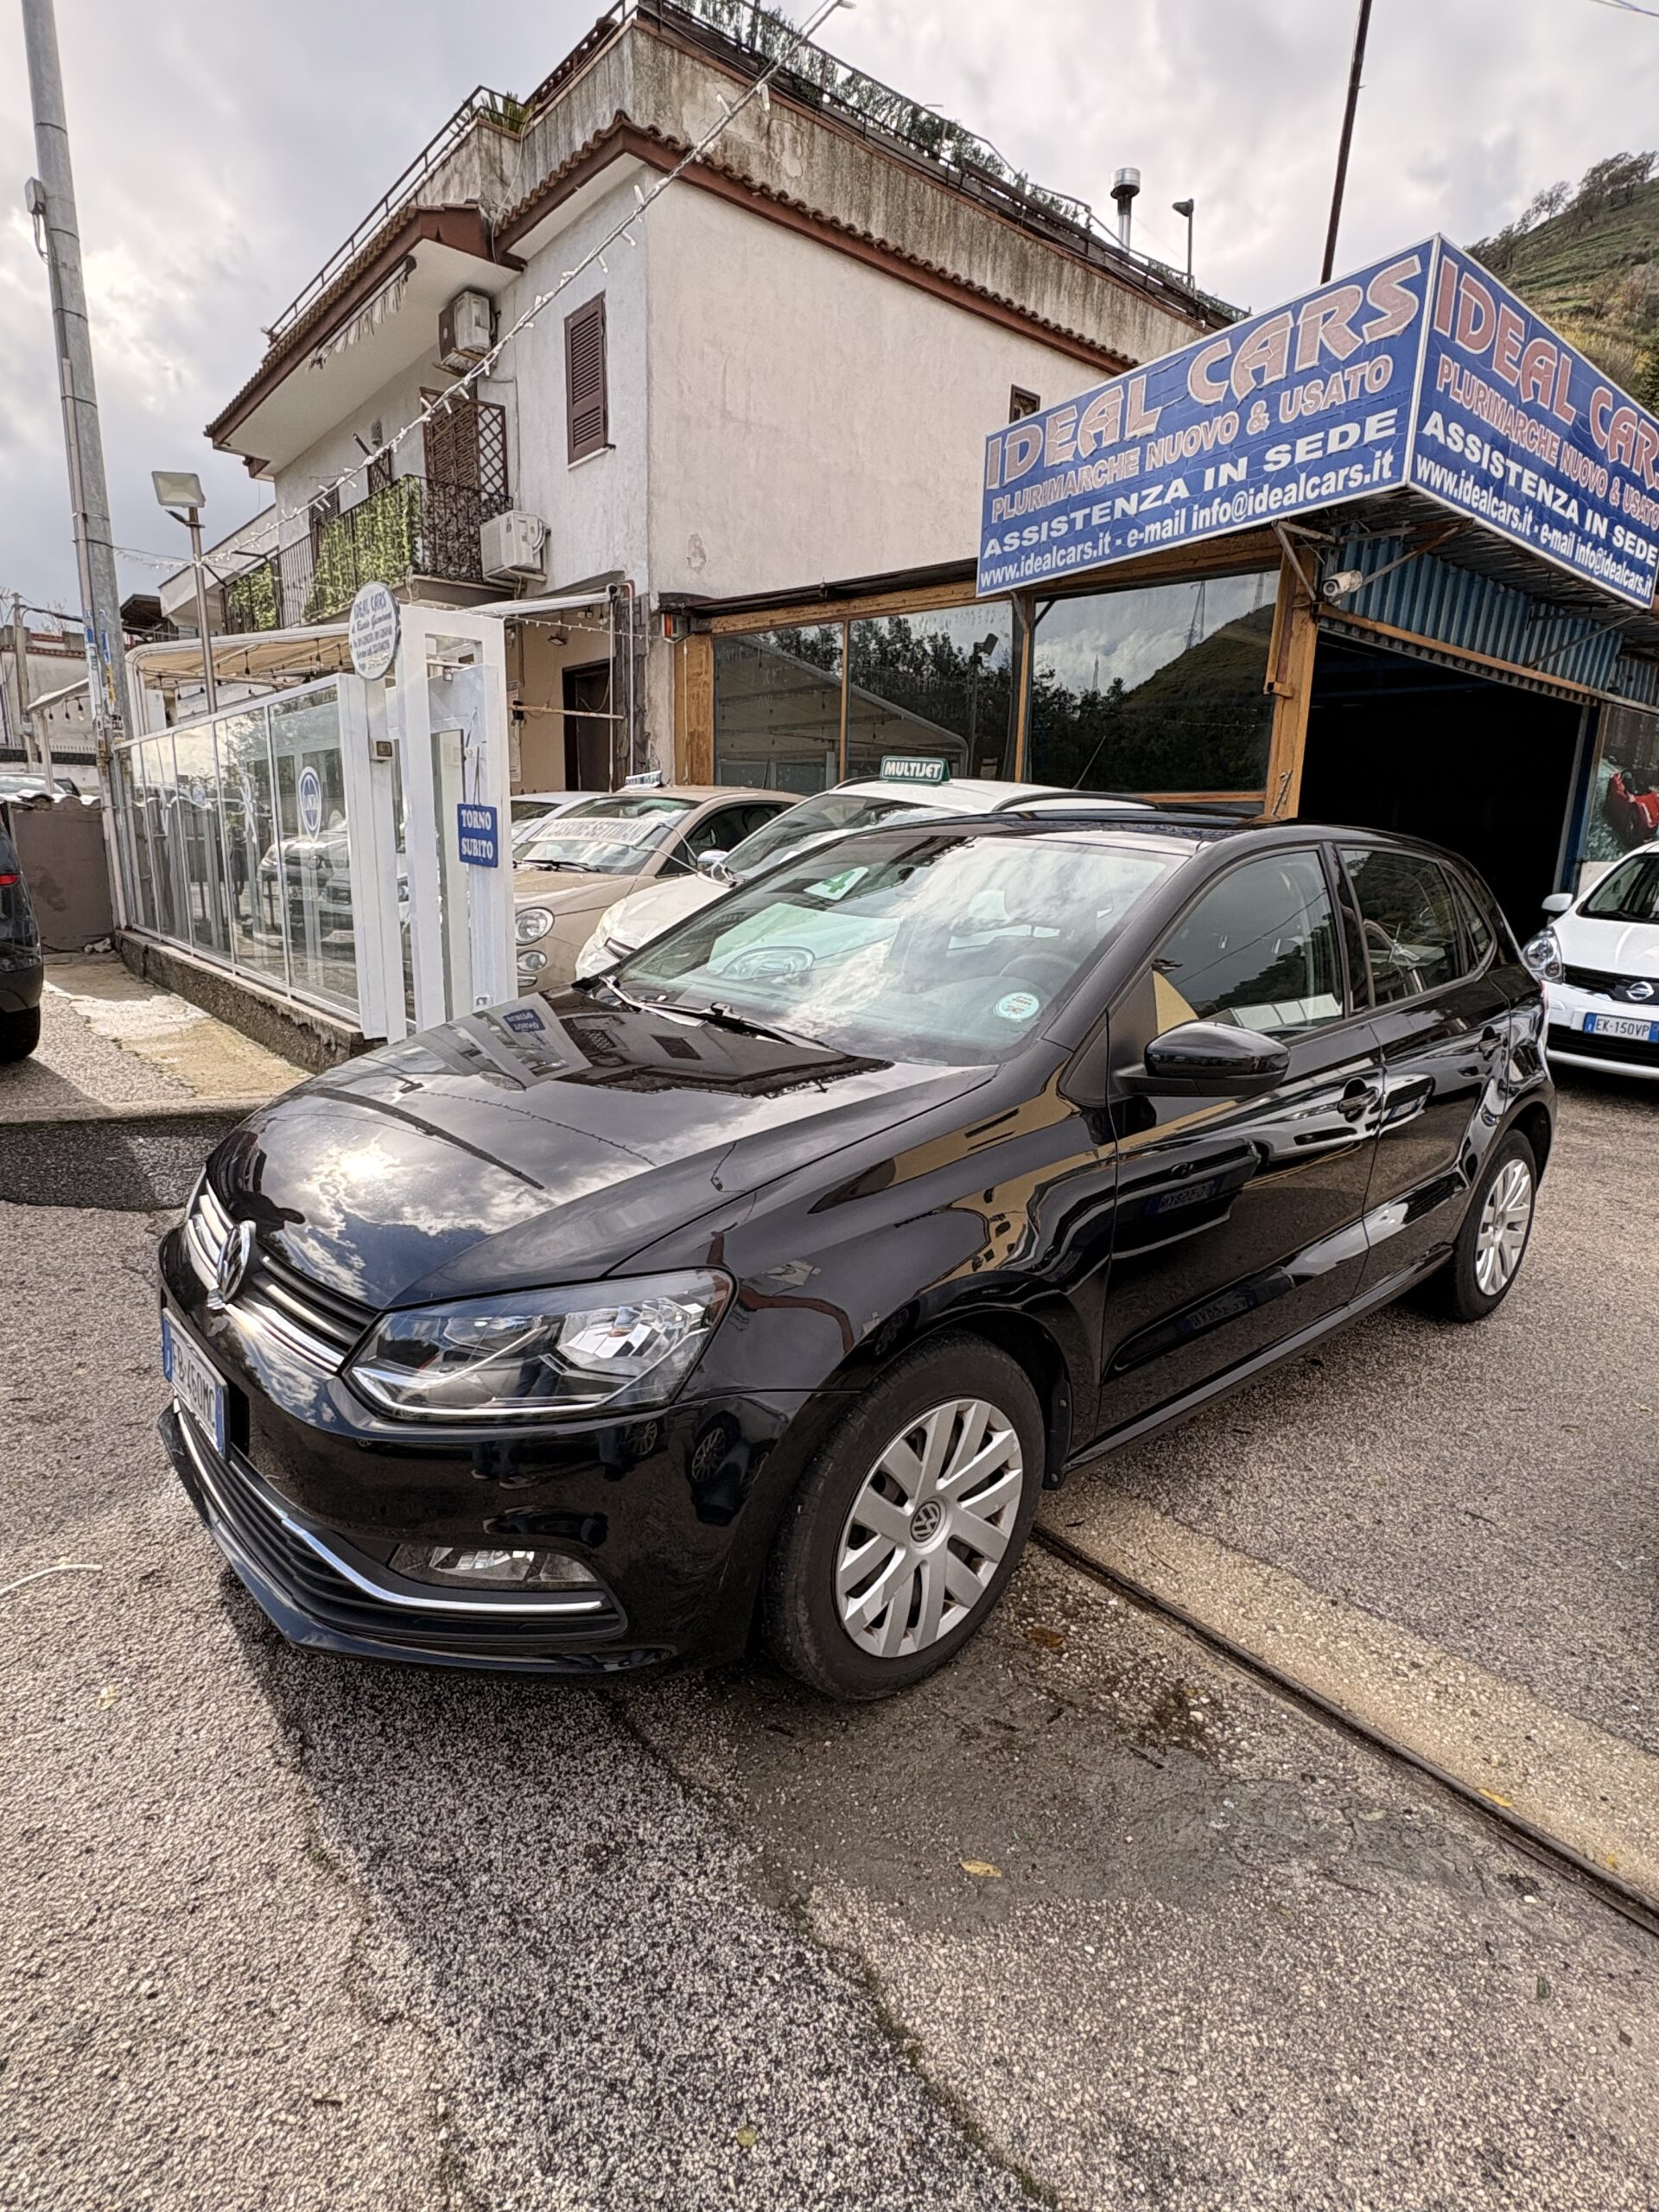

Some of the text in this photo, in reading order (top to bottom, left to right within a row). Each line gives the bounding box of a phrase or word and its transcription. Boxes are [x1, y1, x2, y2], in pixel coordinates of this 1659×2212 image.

[986, 254, 1422, 490] IDEAL CARS
[991, 354, 1394, 524] PLURIMARCHE NUOVO & USATO
[1433, 255, 1659, 491] IDEAL CAR
[1435, 353, 1659, 531] PLURIMARCHE NUOVO & USATO
[979, 530, 1112, 588] www.idealcars.it
[1127, 505, 1186, 550] e-mail
[1192, 452, 1393, 531] info@idealcars.it
[982, 408, 1398, 559] ASSISTENZA IN SEDE
[1414, 453, 1534, 537] www.idealcars.it
[1540, 522, 1576, 559] e-mail
[1574, 536, 1654, 600] info@idealcars.it
[1421, 410, 1659, 568] ASSISTENZA IN SEDE
[461, 809, 492, 830] TORNO
[884, 760, 942, 779] MULTIJET
[461, 837, 493, 860] SUBITO
